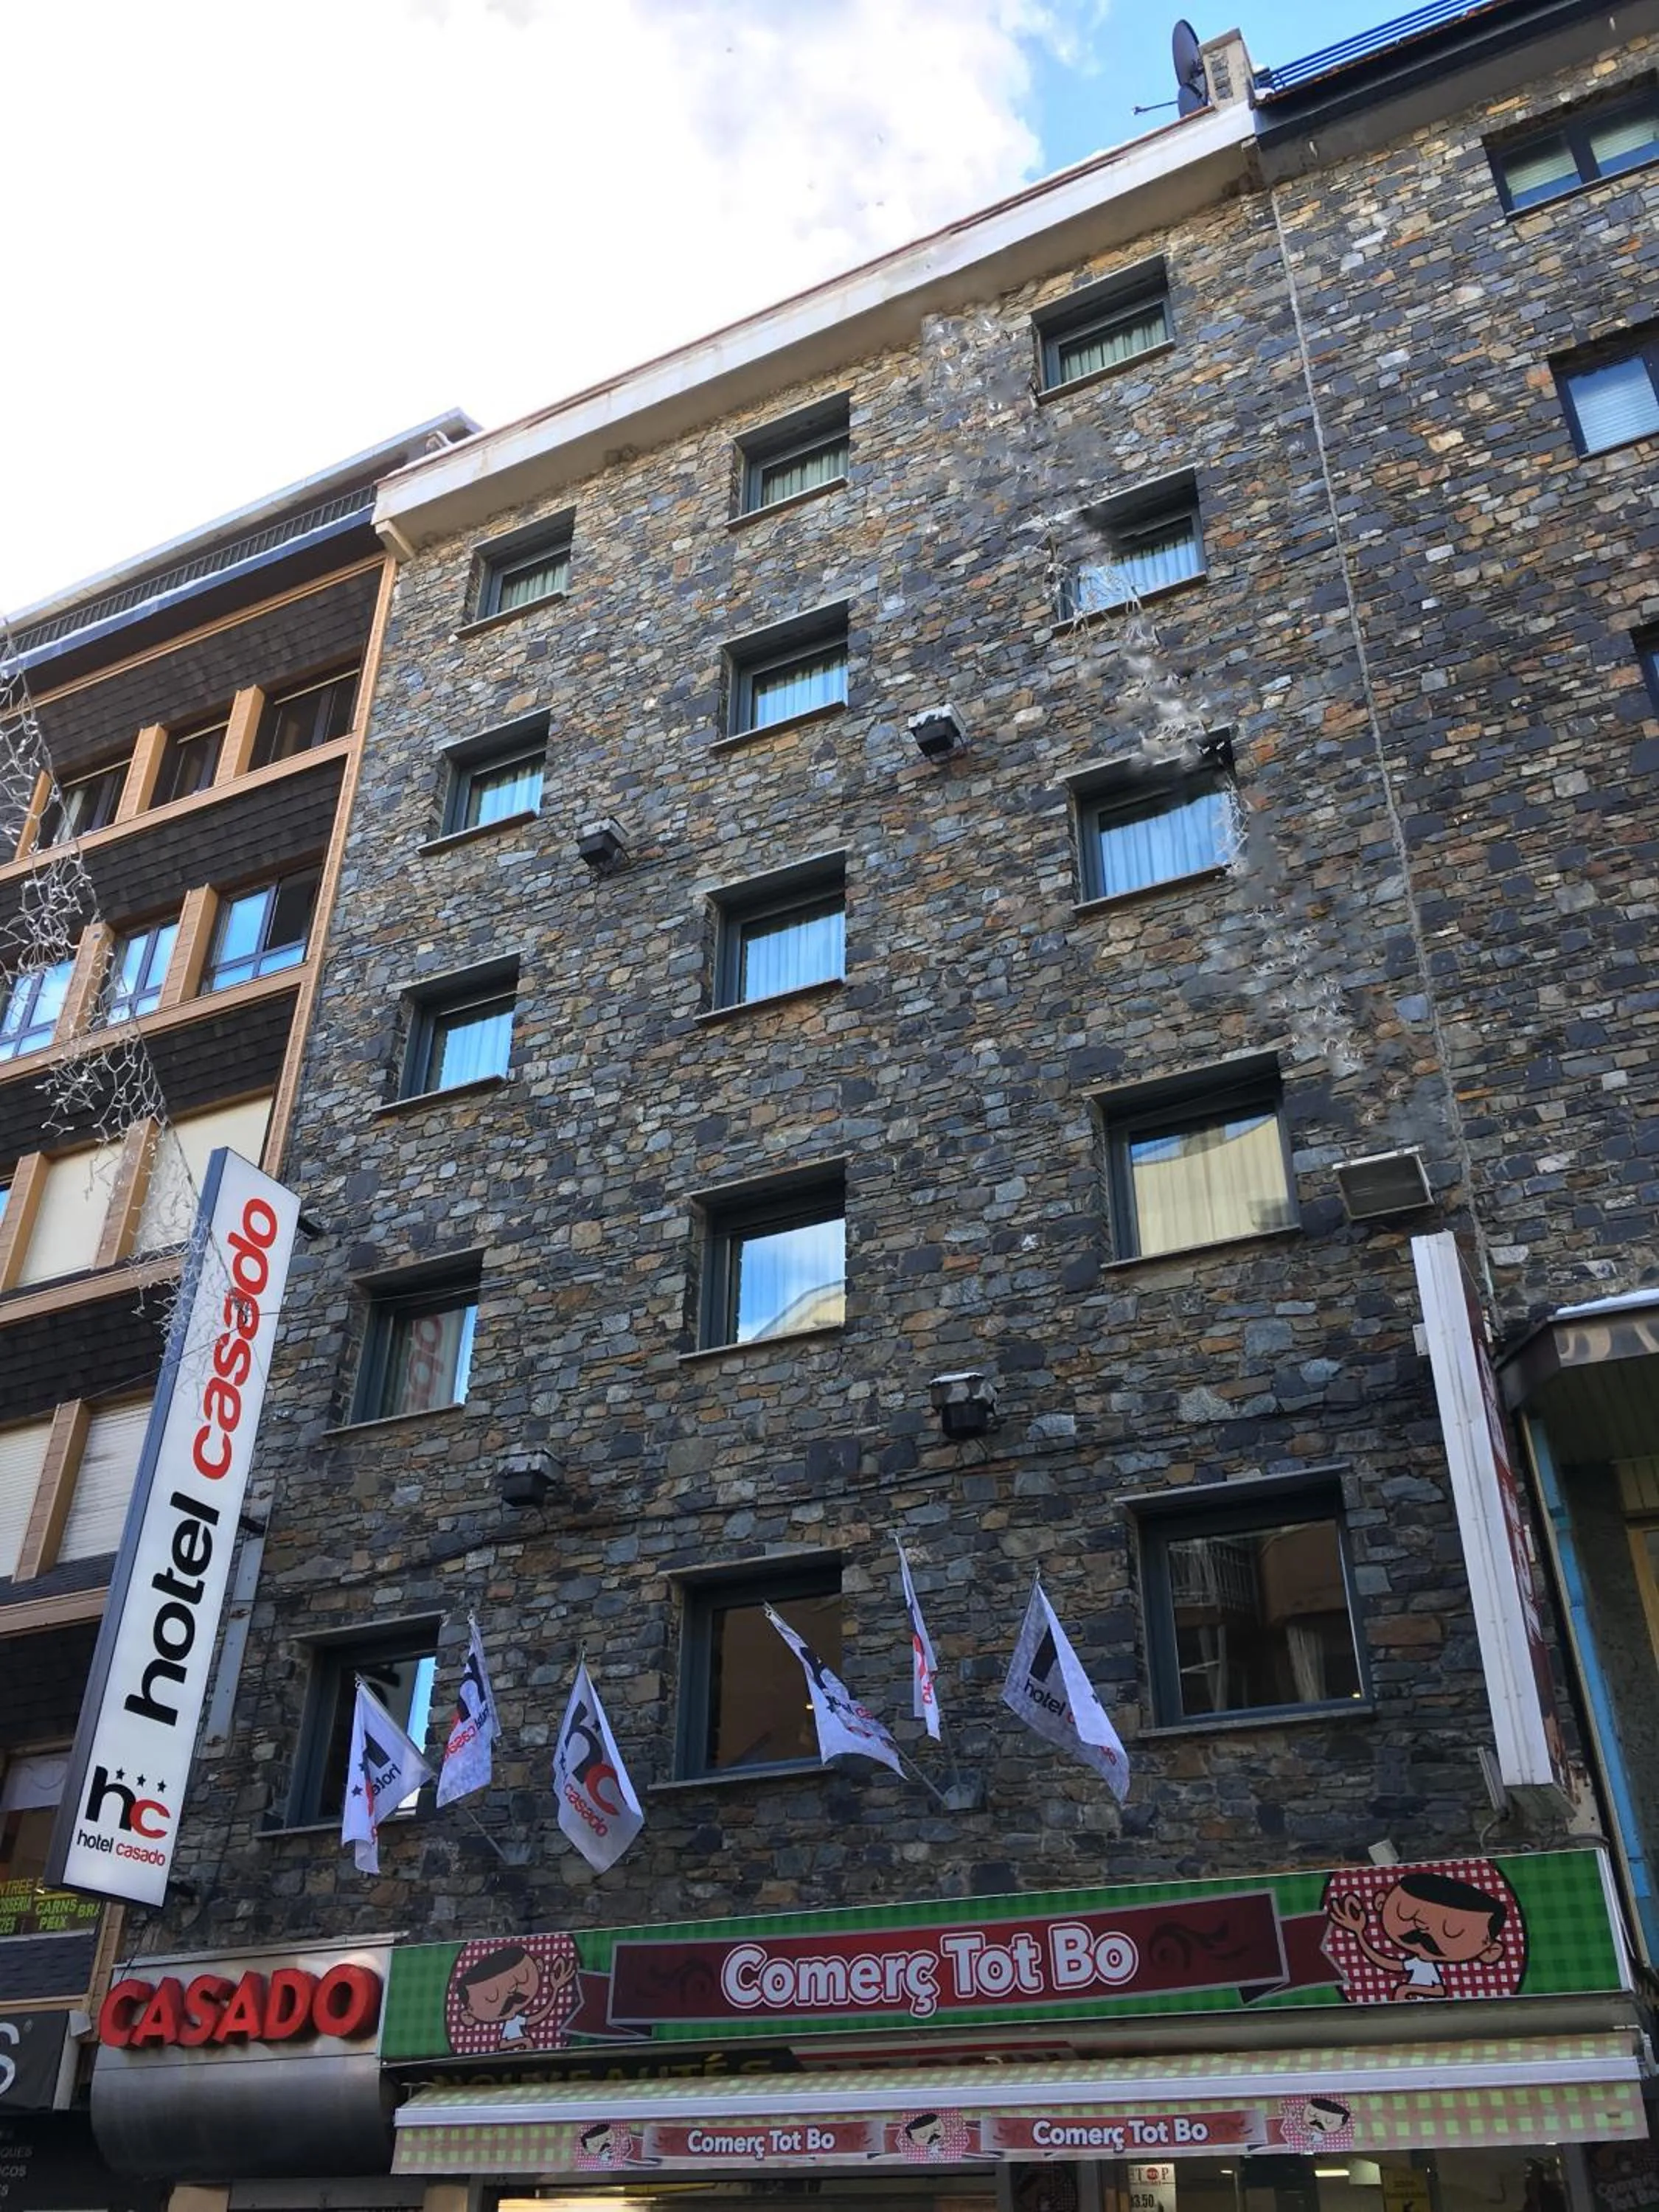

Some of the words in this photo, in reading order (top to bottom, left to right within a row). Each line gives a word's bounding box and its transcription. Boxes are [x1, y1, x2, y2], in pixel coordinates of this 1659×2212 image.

[124, 1492, 220, 1727] hotel
[192, 1198, 278, 1481] casado
[1024, 1678, 1067, 1717] hotel
[85, 1765, 171, 1839] hc
[565, 1783, 608, 1837] casado
[77, 1829, 114, 1854] hotel
[115, 1840, 166, 1866] casado
[722, 1944, 939, 2017] Comerç
[941, 1931, 1043, 1997] Tot
[1048, 1921, 1138, 1990] Bo
[100, 1964, 380, 2048] CASADO
[687, 2129, 765, 2160] Comerç
[769, 2129, 802, 2152] Tot
[807, 2126, 835, 2150] Bo
[1032, 2119, 1125, 2152] Comerç
[1128, 2118, 1169, 2144] Tot
[1173, 2117, 1208, 2142] Bo
